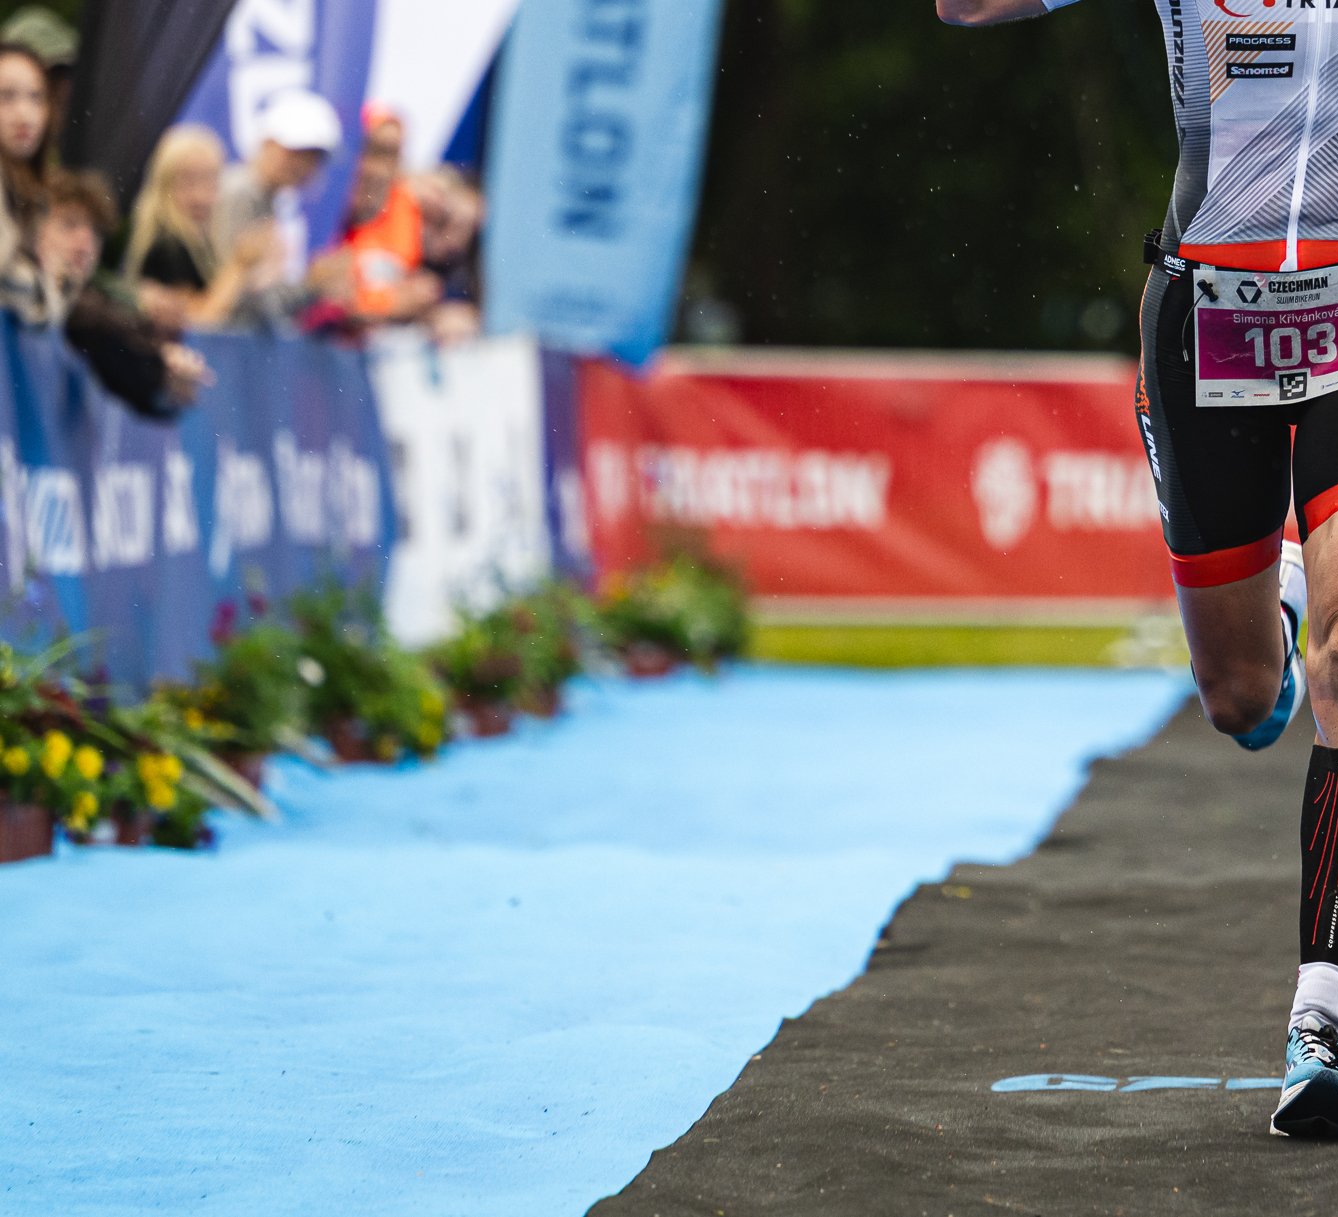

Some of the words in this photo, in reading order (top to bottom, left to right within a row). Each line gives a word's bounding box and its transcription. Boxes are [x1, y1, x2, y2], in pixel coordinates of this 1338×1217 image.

[1230, 65, 1289, 75] Sanomed
[1268, 276, 1328, 293] CZECHMAN
[1233, 313, 1275, 324] Simona
[1245, 322, 1338, 368] 103
